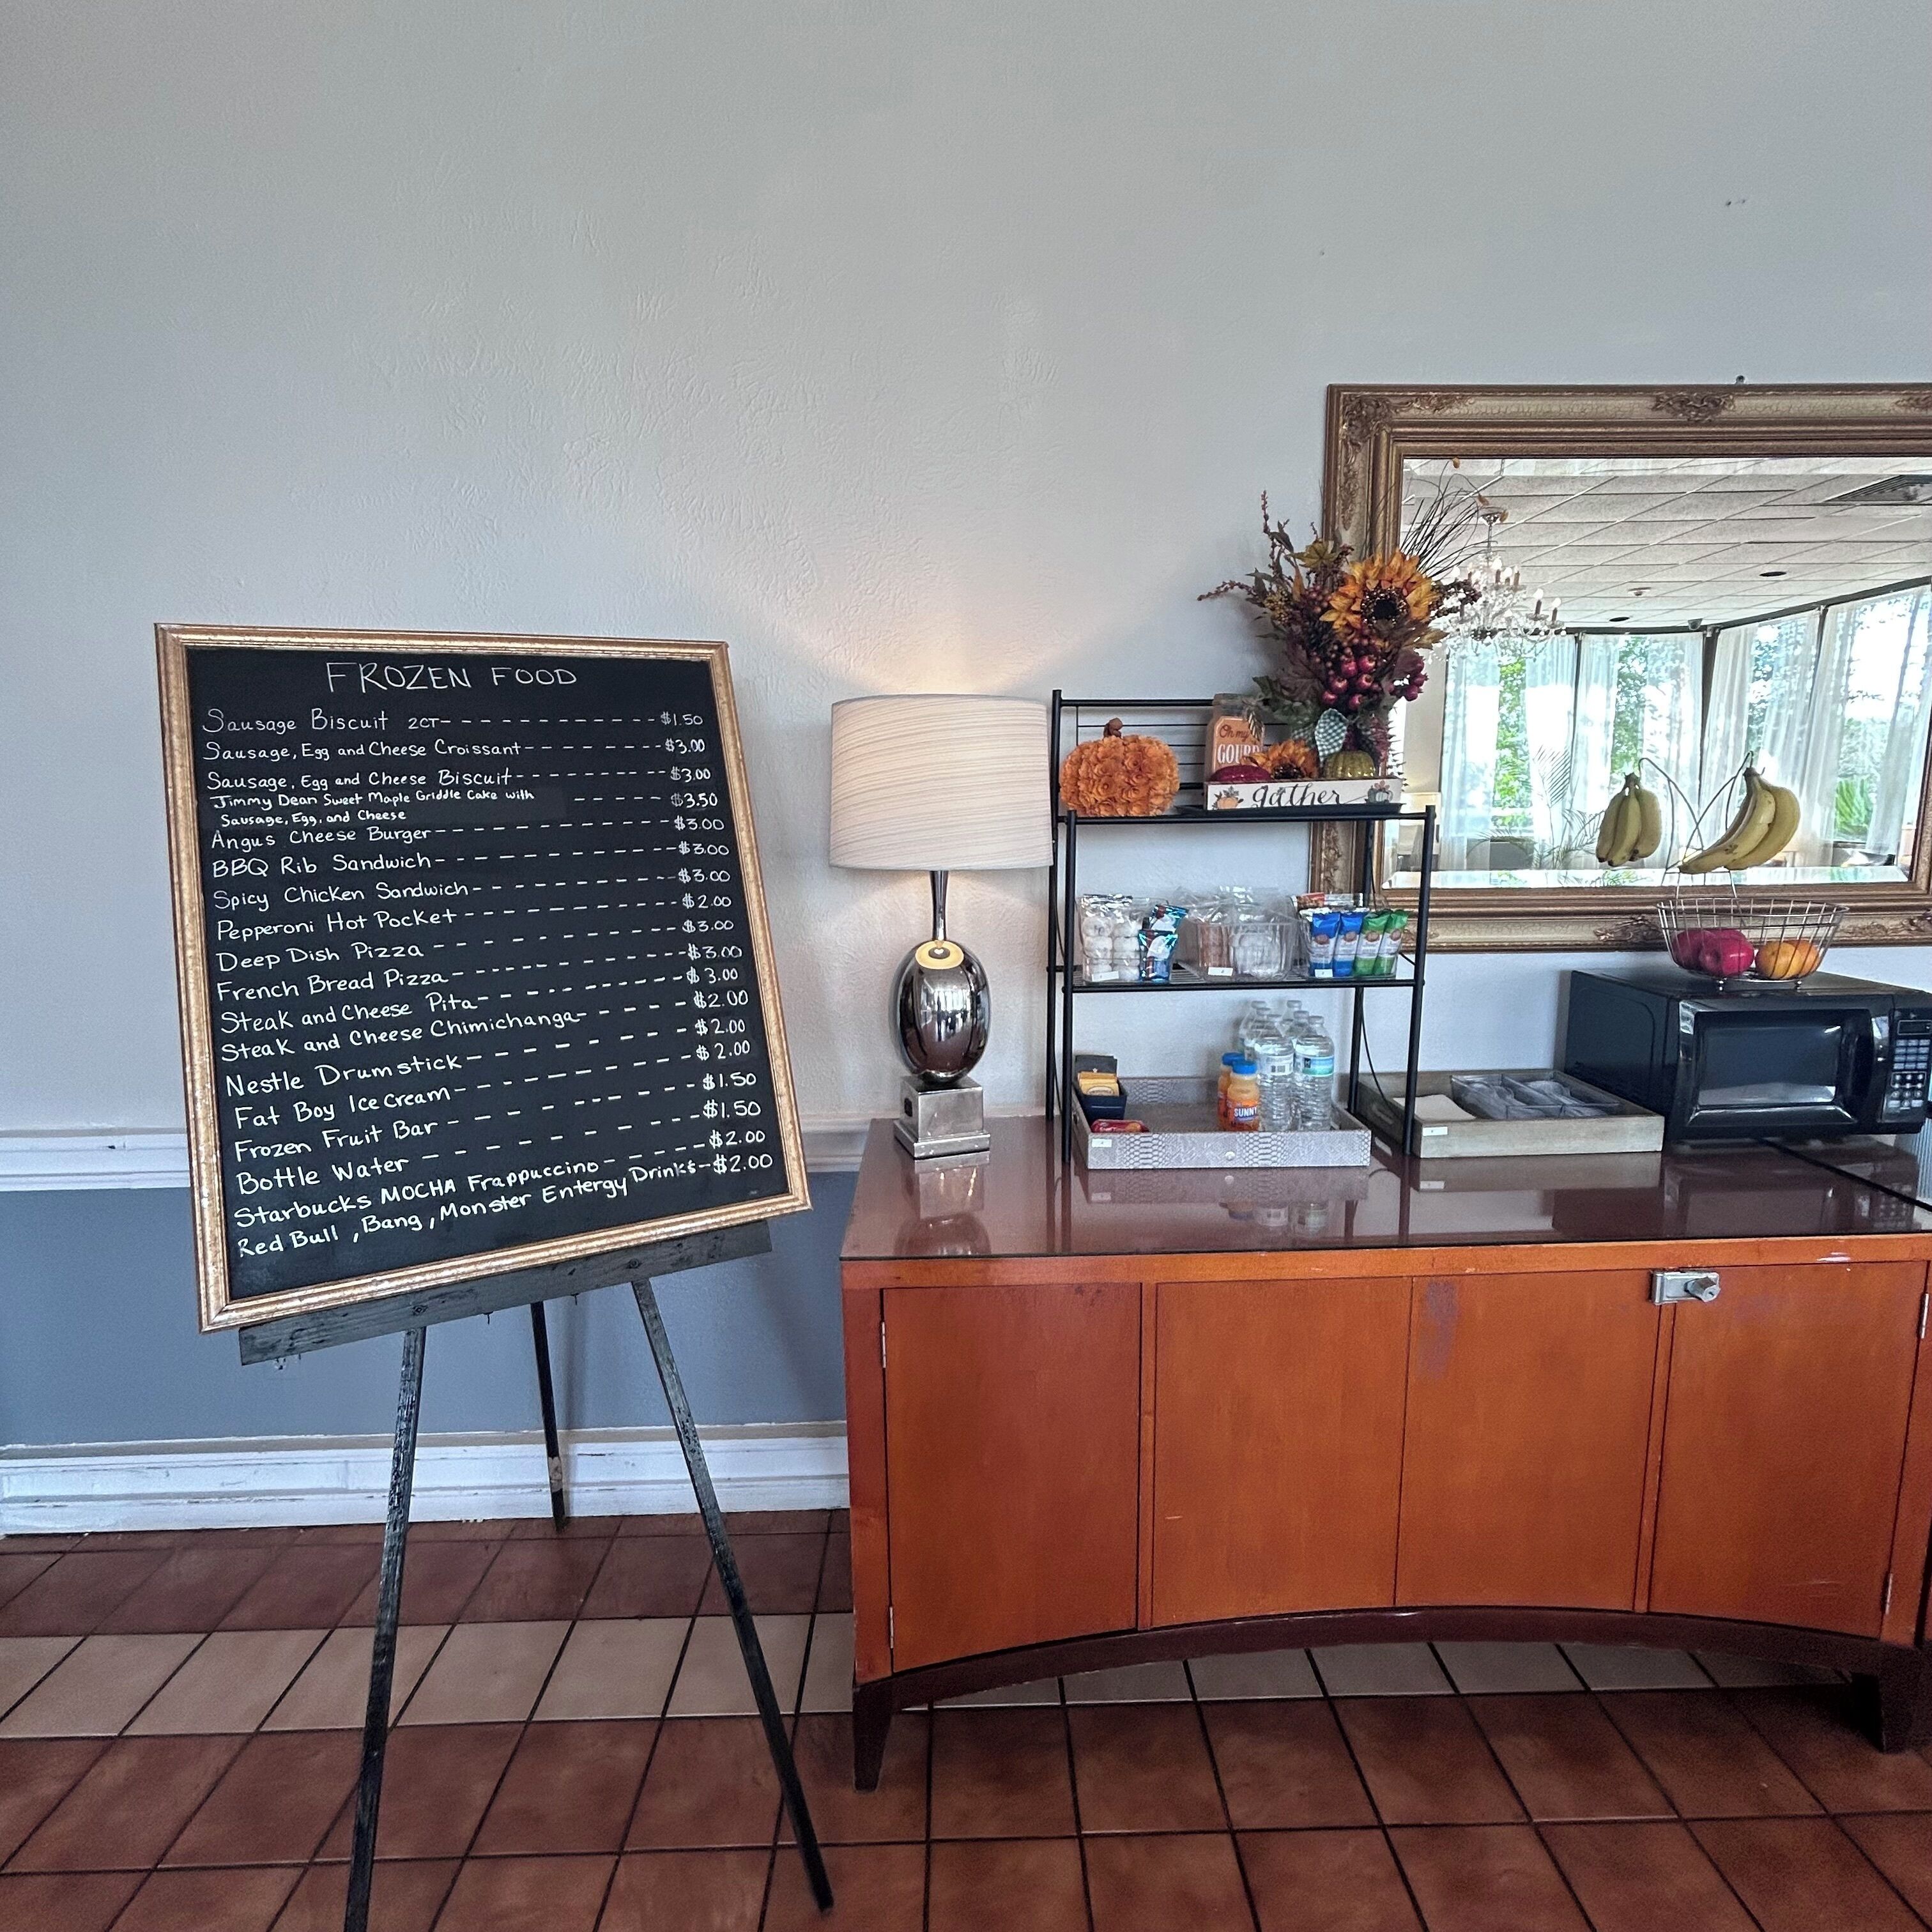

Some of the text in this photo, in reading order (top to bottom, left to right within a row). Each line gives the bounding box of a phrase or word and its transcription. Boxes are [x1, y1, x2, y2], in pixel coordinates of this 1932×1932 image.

[326, 662, 577, 694] FROZEN FOOD
[202, 707, 703, 735] Sausage Biscuit 2CT $1.50
[1220, 724, 1234, 737] Oh
[301, 742, 330, 762] Egg
[337, 744, 365, 756] and
[368, 741, 427, 757] Cheese
[434, 738, 521, 756] Croissant
[664, 737, 705, 755] $3.00
[209, 788, 718, 811] Jimmy Dean Sweet Maple Griddle Cake with $3.50
[300, 774, 328, 792] Egg
[334, 772, 360, 786] and
[368, 771, 427, 786] Cheese
[438, 767, 512, 786] Biscuit
[670, 765, 711, 783] $3.00
[1252, 783, 1347, 808] gather
[211, 815, 724, 853] Angus Cheese Burger $3.00
[326, 810, 350, 823] and
[357, 809, 407, 821] Cheese
[212, 840, 730, 878] BBQ Rib Sandwich $3.00
[213, 890, 270, 912] Spicy
[375, 881, 469, 900] Sandwich
[677, 867, 731, 884] $3.00
[217, 919, 314, 942] Pepperoni
[326, 911, 368, 933] Hot
[682, 892, 732, 910] $2.00
[215, 919, 734, 972] Deep Dish Pizza $3.00
[217, 942, 742, 1002] French Bread Pizza $3.00
[301, 1006, 337, 1025] and
[341, 1004, 413, 1021] Cheese
[425, 992, 479, 1013] Pita
[686, 965, 739, 985] $3.00
[303, 1033, 341, 1052] and
[349, 1027, 423, 1046] Cheese
[430, 1011, 581, 1037] Chimichanga
[693, 989, 749, 1009] $2.00
[226, 1071, 305, 1097] Nestle
[694, 1018, 746, 1037] $2.00
[234, 1105, 280, 1130] Fat
[293, 1101, 335, 1123] Boy
[695, 1039, 751, 1061] $2.00
[234, 1071, 757, 1163] Frozen Fruit Bar $1.50
[235, 1099, 762, 1195] Bottle Water $1.50
[234, 1129, 765, 1228] Starbucks MOCHA Frappuccino $2.00
[237, 1234, 284, 1258] Red
[628, 1159, 696, 1183] Drinks
[712, 1153, 774, 1176] $2.00
